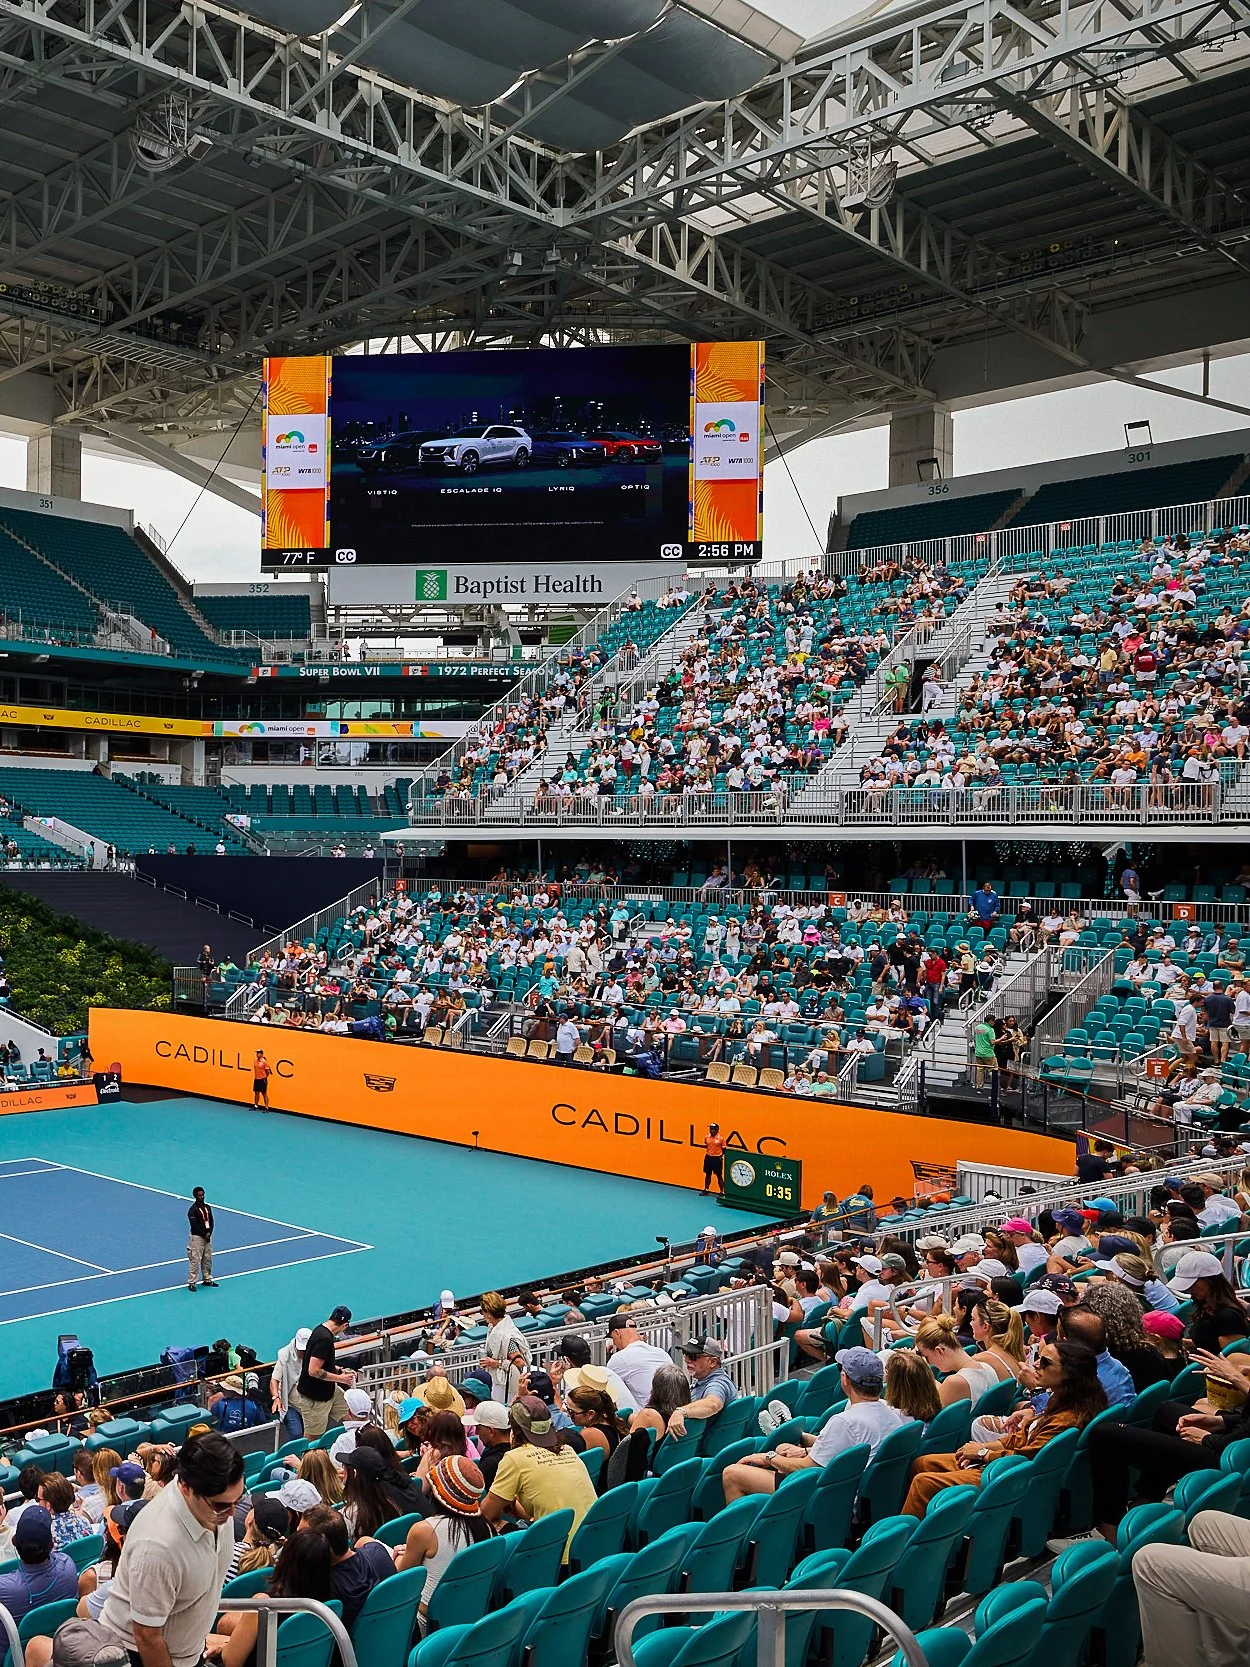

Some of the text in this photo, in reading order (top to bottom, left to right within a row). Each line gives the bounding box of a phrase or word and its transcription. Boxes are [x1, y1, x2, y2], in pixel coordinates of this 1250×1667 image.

[1127, 451, 1153, 464] 301
[928, 483, 950, 496] 356
[39, 499, 54, 510] 351
[337, 551, 354, 562] CC
[662, 545, 681, 557] CC
[698, 544, 754, 557] 2:56 PM
[282, 552, 315, 565] 77° F
[249, 583, 270, 594] 352
[453, 573, 603, 599] Baptist Health
[364, 666, 380, 676] VII
[437, 666, 467, 676] 1972
[84, 716, 141, 729] CADILLAC
[267, 724, 288, 732] miami
[288, 726, 305, 734] open
[1179, 909, 1189, 918] D
[155, 1040, 295, 1079] CADILLC
[1154, 1065, 1162, 1075] E
[765, 1169, 793, 1181] ROLEX
[766, 1183, 792, 1201] 0:35
